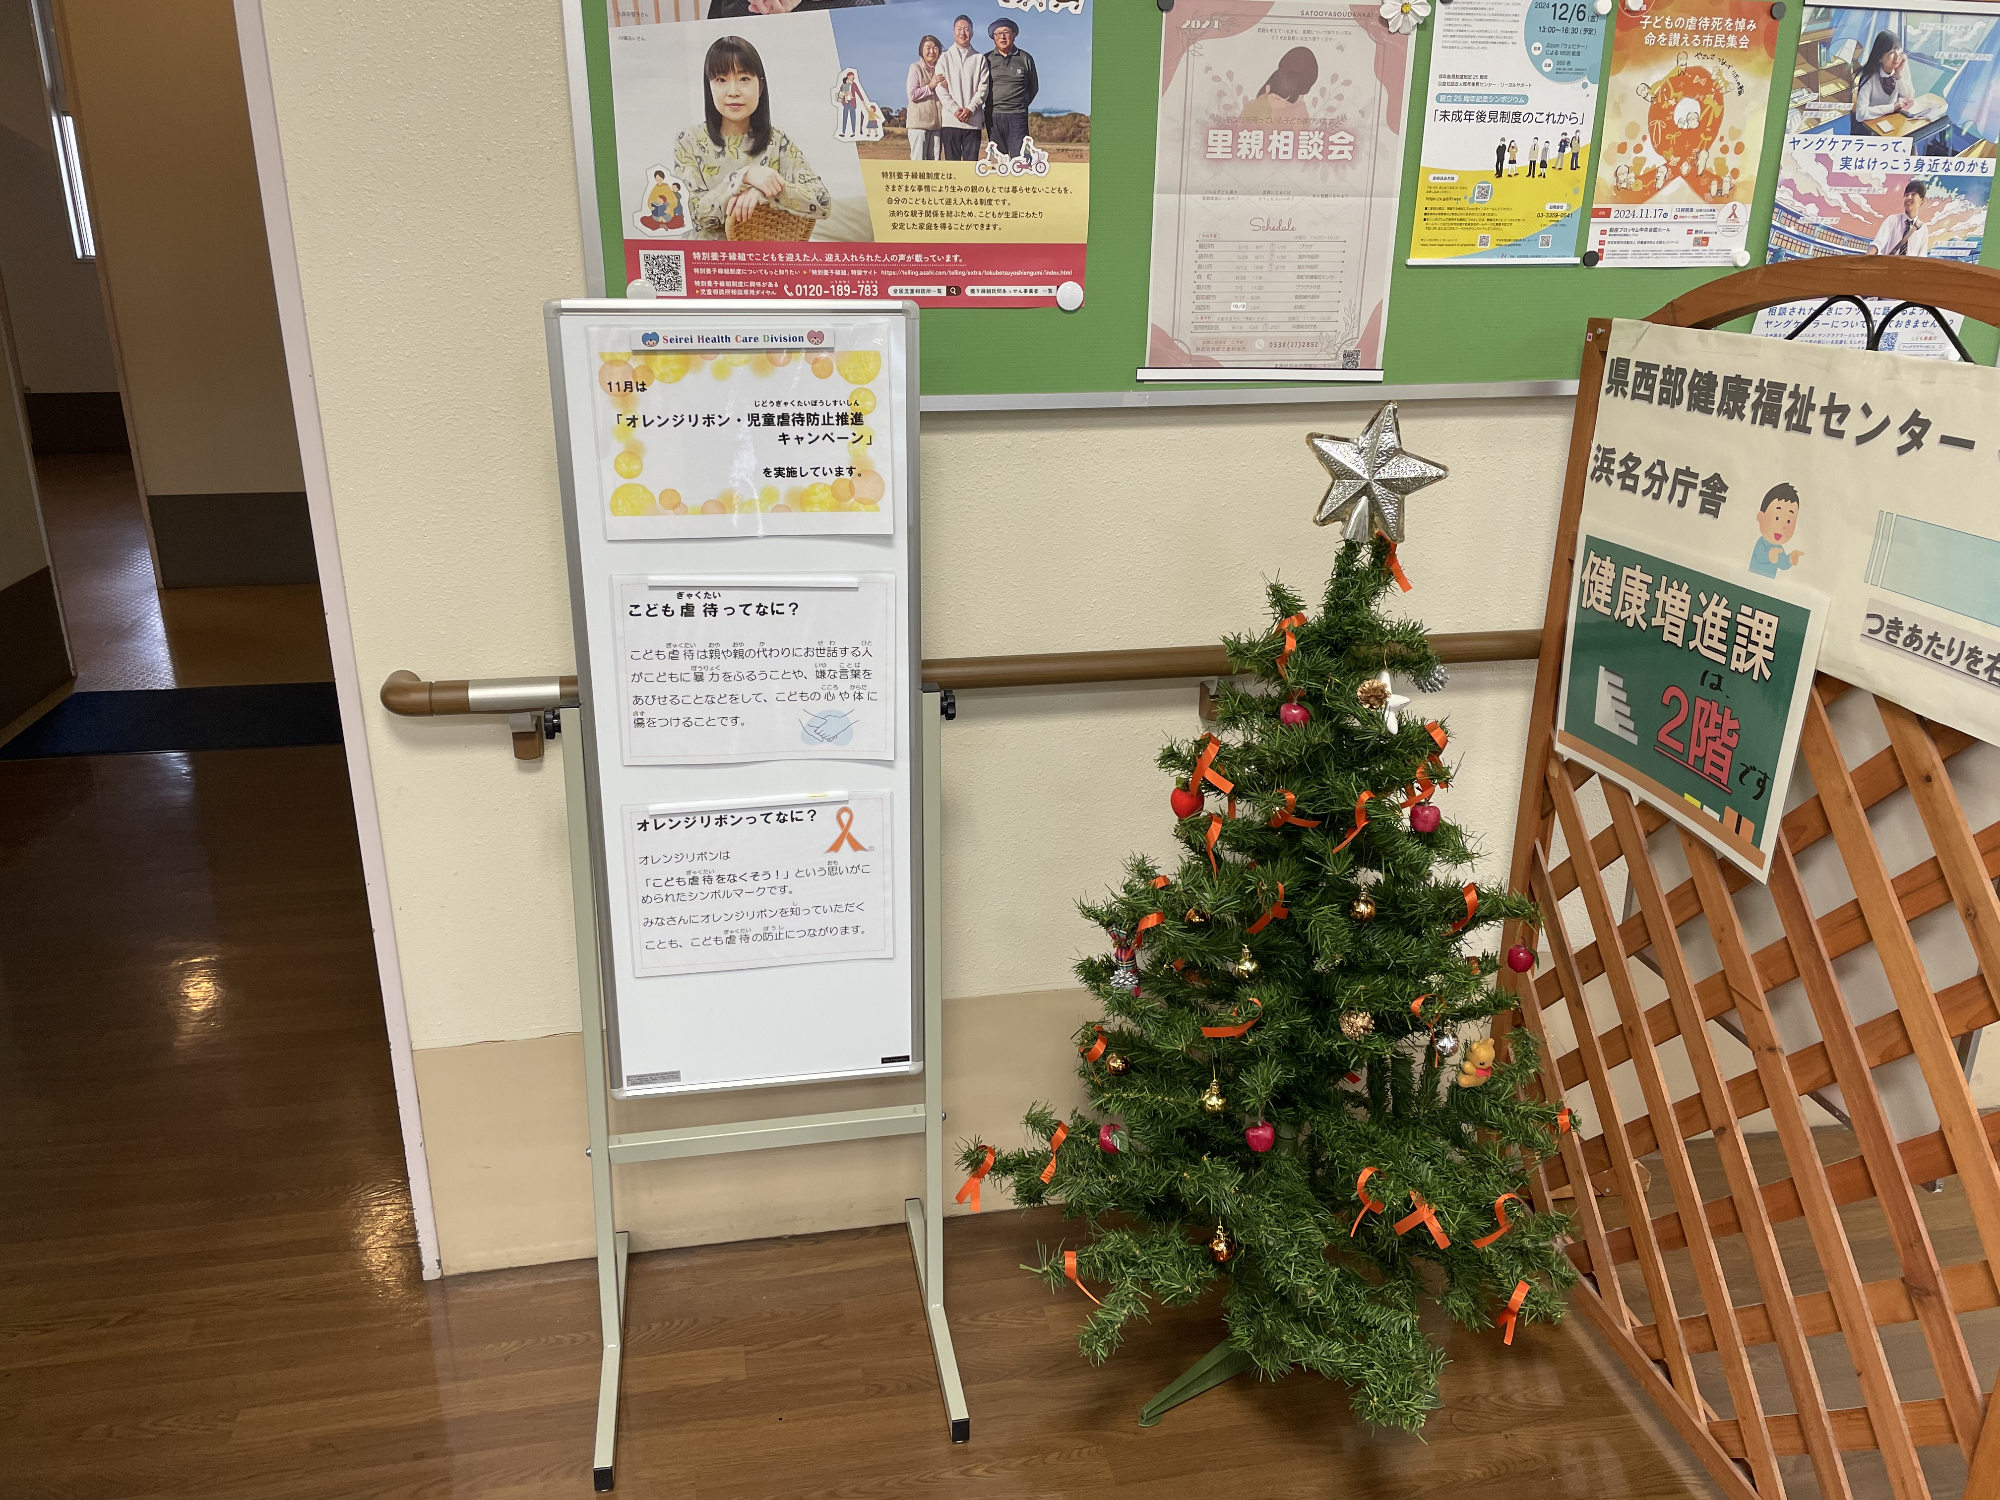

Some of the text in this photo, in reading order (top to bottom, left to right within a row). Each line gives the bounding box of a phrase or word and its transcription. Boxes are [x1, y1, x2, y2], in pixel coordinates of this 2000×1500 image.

[1534, 1, 1550, 9] 2024
[1551, 2, 1587, 24] 12/6
[1639, 15, 1758, 32] 子どもの虐待死を悼み
[1644, 31, 1751, 49] 命を讃える市民集会
[1433, 109, 1586, 126] 「未成年後見制度のこれから」
[1205, 129, 1356, 161] 里親相談会
[1788, 136, 1908, 153] ヤングケアラーって、
[1839, 156, 1990, 174] 実はけっこう身近なのかも
[881, 171, 957, 181] 特別養子縁組制度とは、
[884, 184, 1074, 195] さまざまな事情により生みの親のもとでは暮らせないこどもを、
[886, 196, 1012, 206] 自分のこどもとして迎え入れる制度です。
[888, 209, 1044, 219] 法的な親子関係を結ぶため、こどもが生涯にわたり
[1613, 207, 1664, 219] 2024.11.17
[891, 222, 1003, 231] 安定した家庭を得ることができます。
[1249, 217, 1297, 232] Schedule
[692, 251, 964, 264] 特別養子縁組でこどもを迎えた人、迎え入れられた人の声が載っています。
[795, 284, 879, 297] 0120-189-783
[662, 333, 804, 344] Seirei Health Care Division
[606, 380, 648, 394] 11月は
[1605, 356, 1976, 457] 県西部健康福祉センター
[616, 411, 865, 429] 「オレンジリボン・児童虐待防止推進
[777, 431, 874, 446] キャンペーン」
[762, 465, 863, 479] を実施しています。
[1589, 442, 1730, 519] 浜名分庁舎
[675, 590, 722, 600] ぎゃくたい
[1580, 549, 1780, 682] 健康増進課
[630, 646, 873, 662] こども虐待は親や親の代わりにお世話する人
[631, 668, 873, 684] がこどもに暴力をふるうことや、嫌な言葉を
[632, 690, 878, 706] あびせることなどをして、こどもの心や体に
[633, 716, 746, 730] 傷をつけることです。
[1655, 684, 1741, 787] 2階
[1738, 761, 1772, 801] です
[636, 808, 817, 833] オレンジリボンってなに？
[638, 850, 731, 866] オレンジリボンは
[641, 886, 794, 905] められたシンボルマークです。
[642, 901, 865, 928] みなさんにオレンジリボンを知っていただく
[644, 924, 866, 950] ことも、こども虐待の防止につながります。
